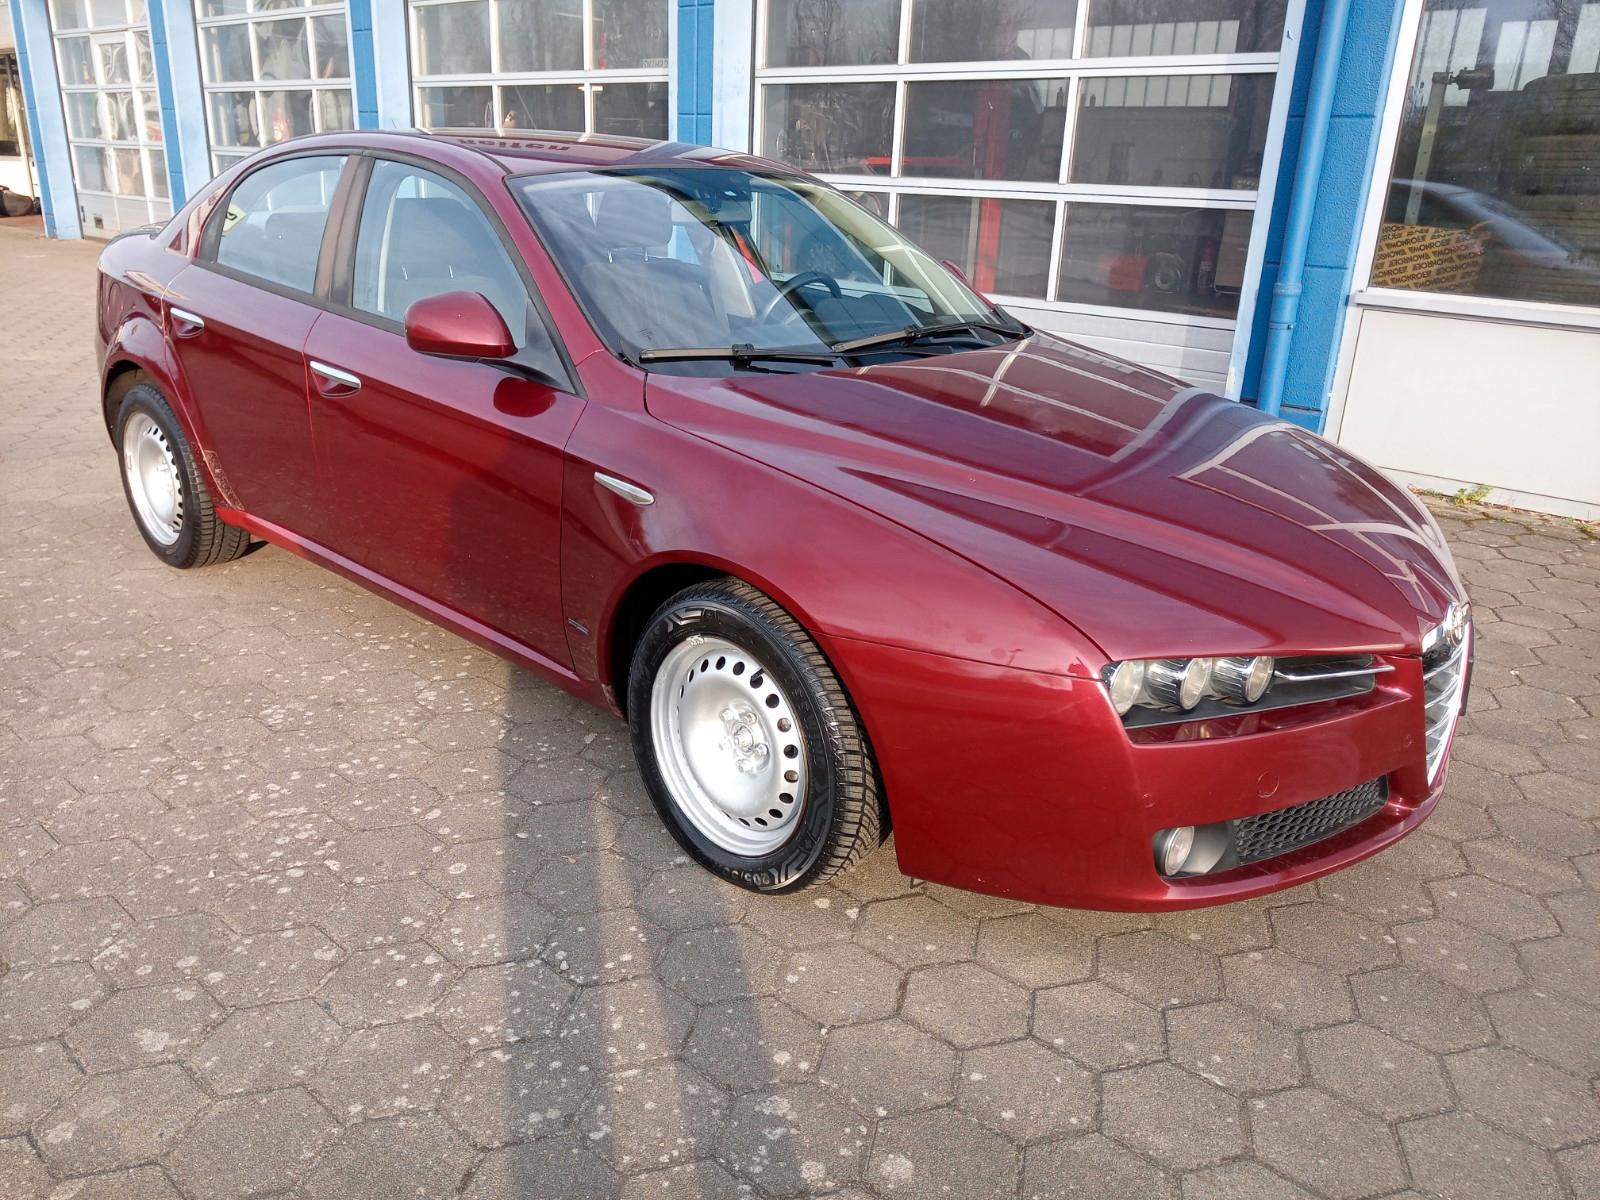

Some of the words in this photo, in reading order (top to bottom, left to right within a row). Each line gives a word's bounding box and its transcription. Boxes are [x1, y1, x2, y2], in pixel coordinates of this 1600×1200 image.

[1386, 235, 1426, 248] MONROE
[1408, 239, 1449, 253] MONROE
[1391, 270, 1431, 283] MONROE
